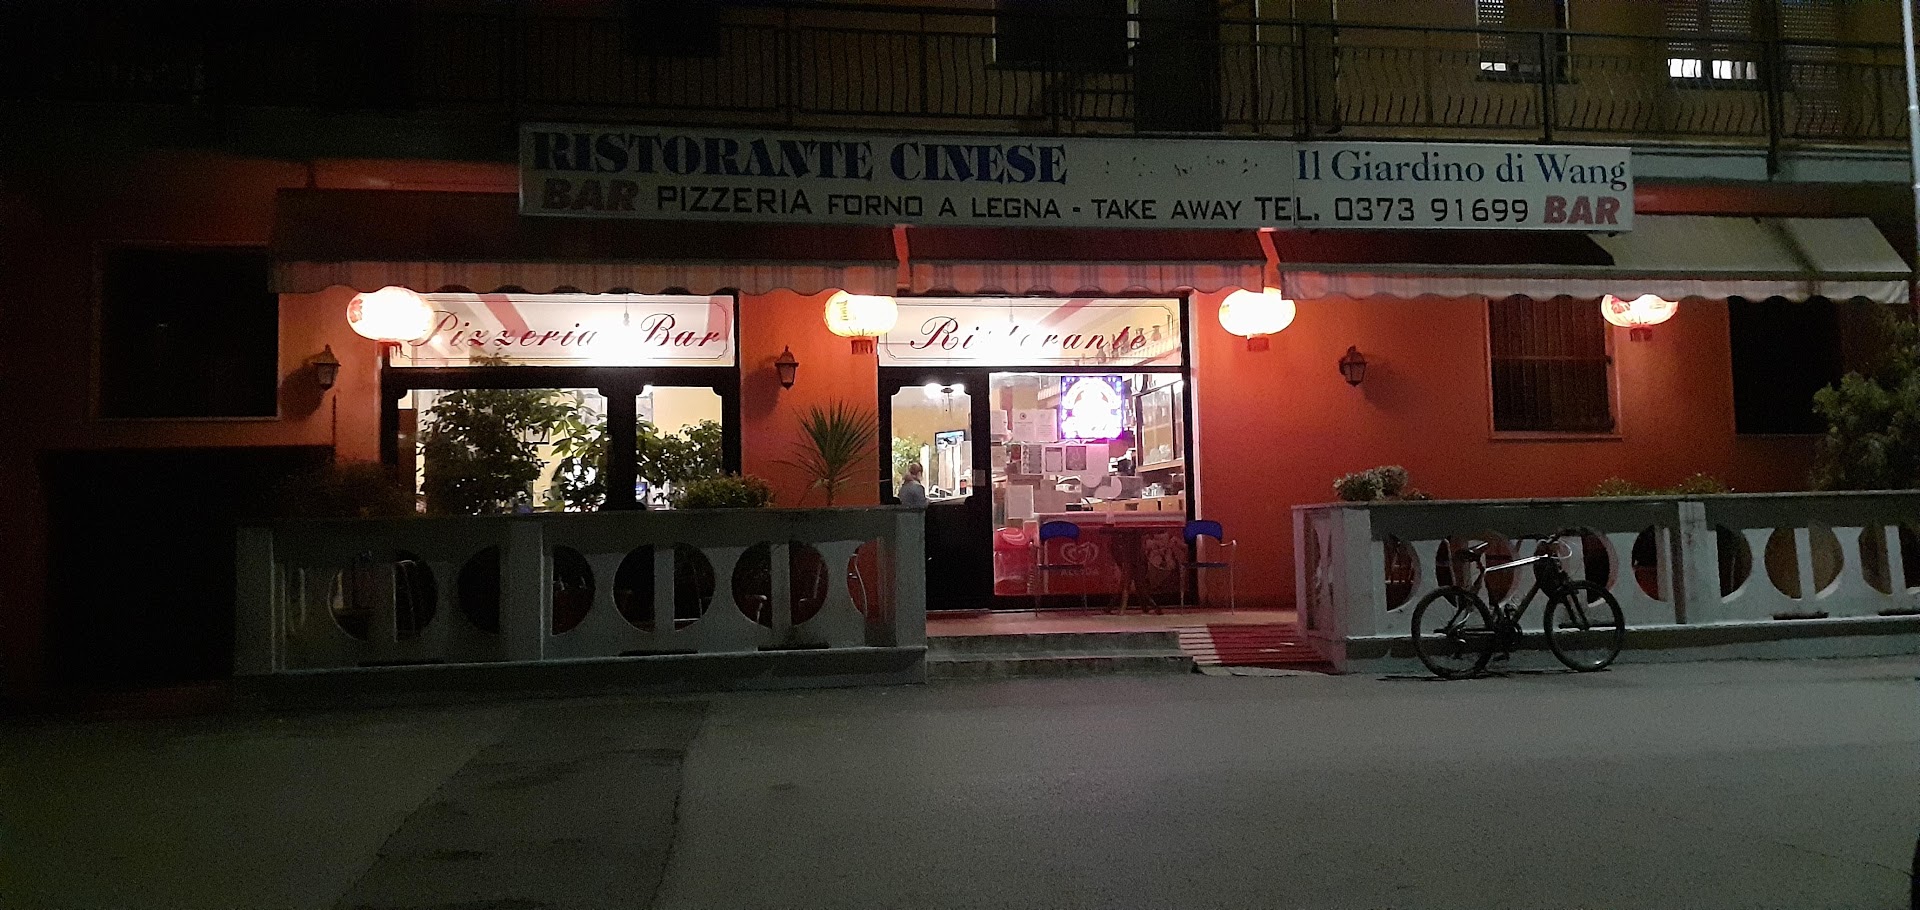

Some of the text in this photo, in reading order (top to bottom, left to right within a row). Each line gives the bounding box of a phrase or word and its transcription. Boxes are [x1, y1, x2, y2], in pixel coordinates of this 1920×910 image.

[533, 130, 1068, 185] RISTORANTE CINESE
[1296, 149, 1628, 191] Il Giardino di Wang
[541, 178, 639, 212] BAR
[656, 185, 813, 215] PIZZERIA
[828, 194, 923, 217] FORNO
[938, 199, 957, 217] A
[971, 197, 1061, 219] LEGNA
[1091, 199, 1157, 220] TAKE
[1171, 199, 1242, 221] AWAY
[1254, 196, 1320, 222] TEL.
[1334, 197, 1415, 222] 0373
[1431, 199, 1529, 222] 91699
[1543, 195, 1621, 225] BAR
[407, 310, 720, 347] Pizzeria Bar
